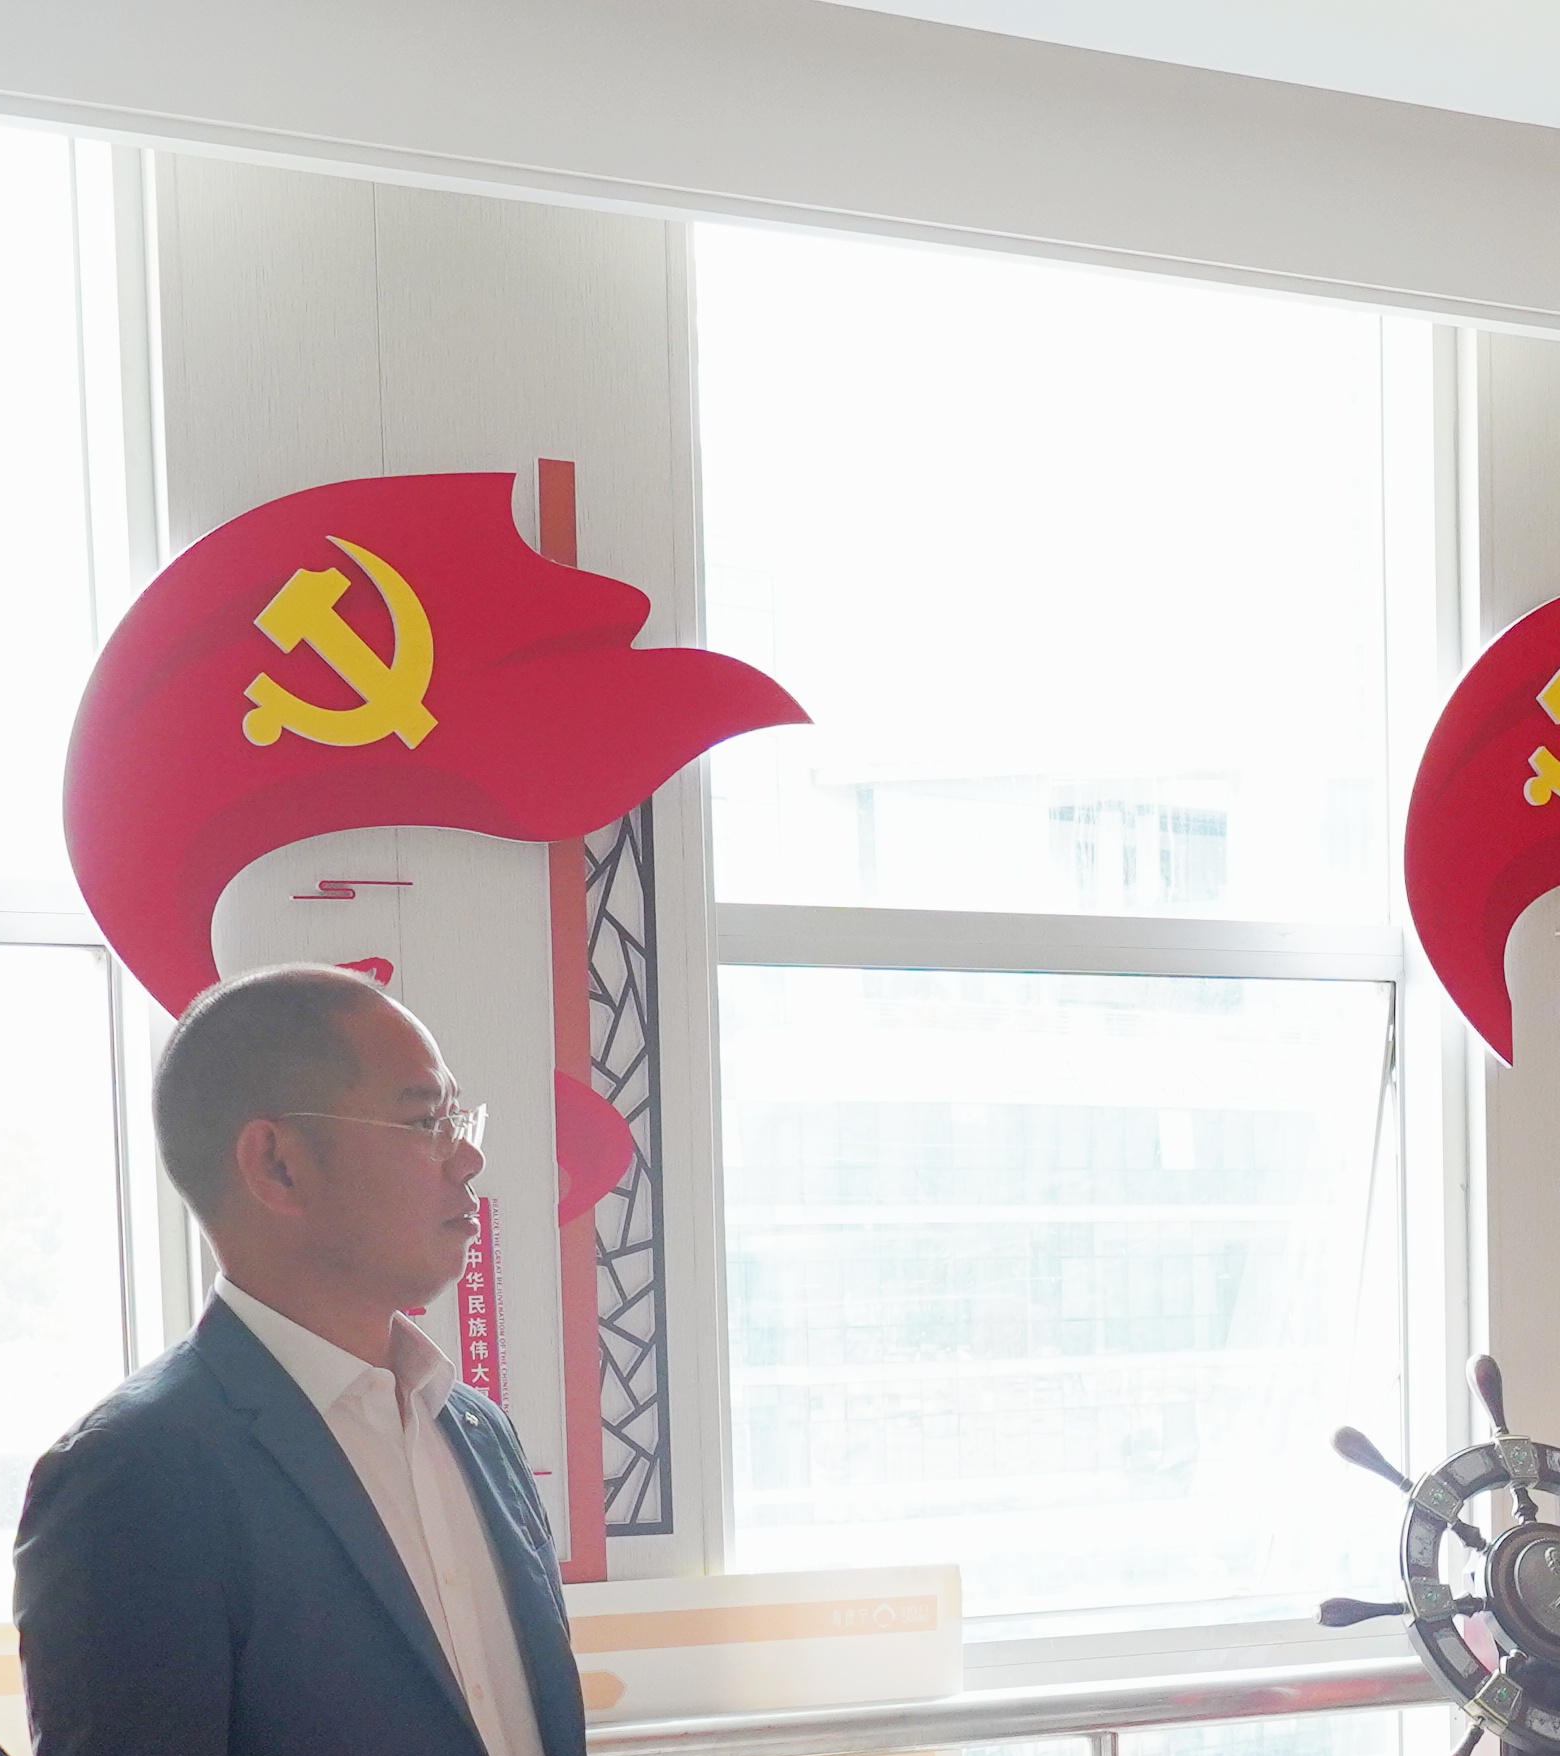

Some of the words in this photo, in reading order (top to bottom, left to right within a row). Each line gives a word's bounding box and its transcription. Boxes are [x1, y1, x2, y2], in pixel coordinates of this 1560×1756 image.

[466, 1235, 489, 1397] 中华民族伟大
